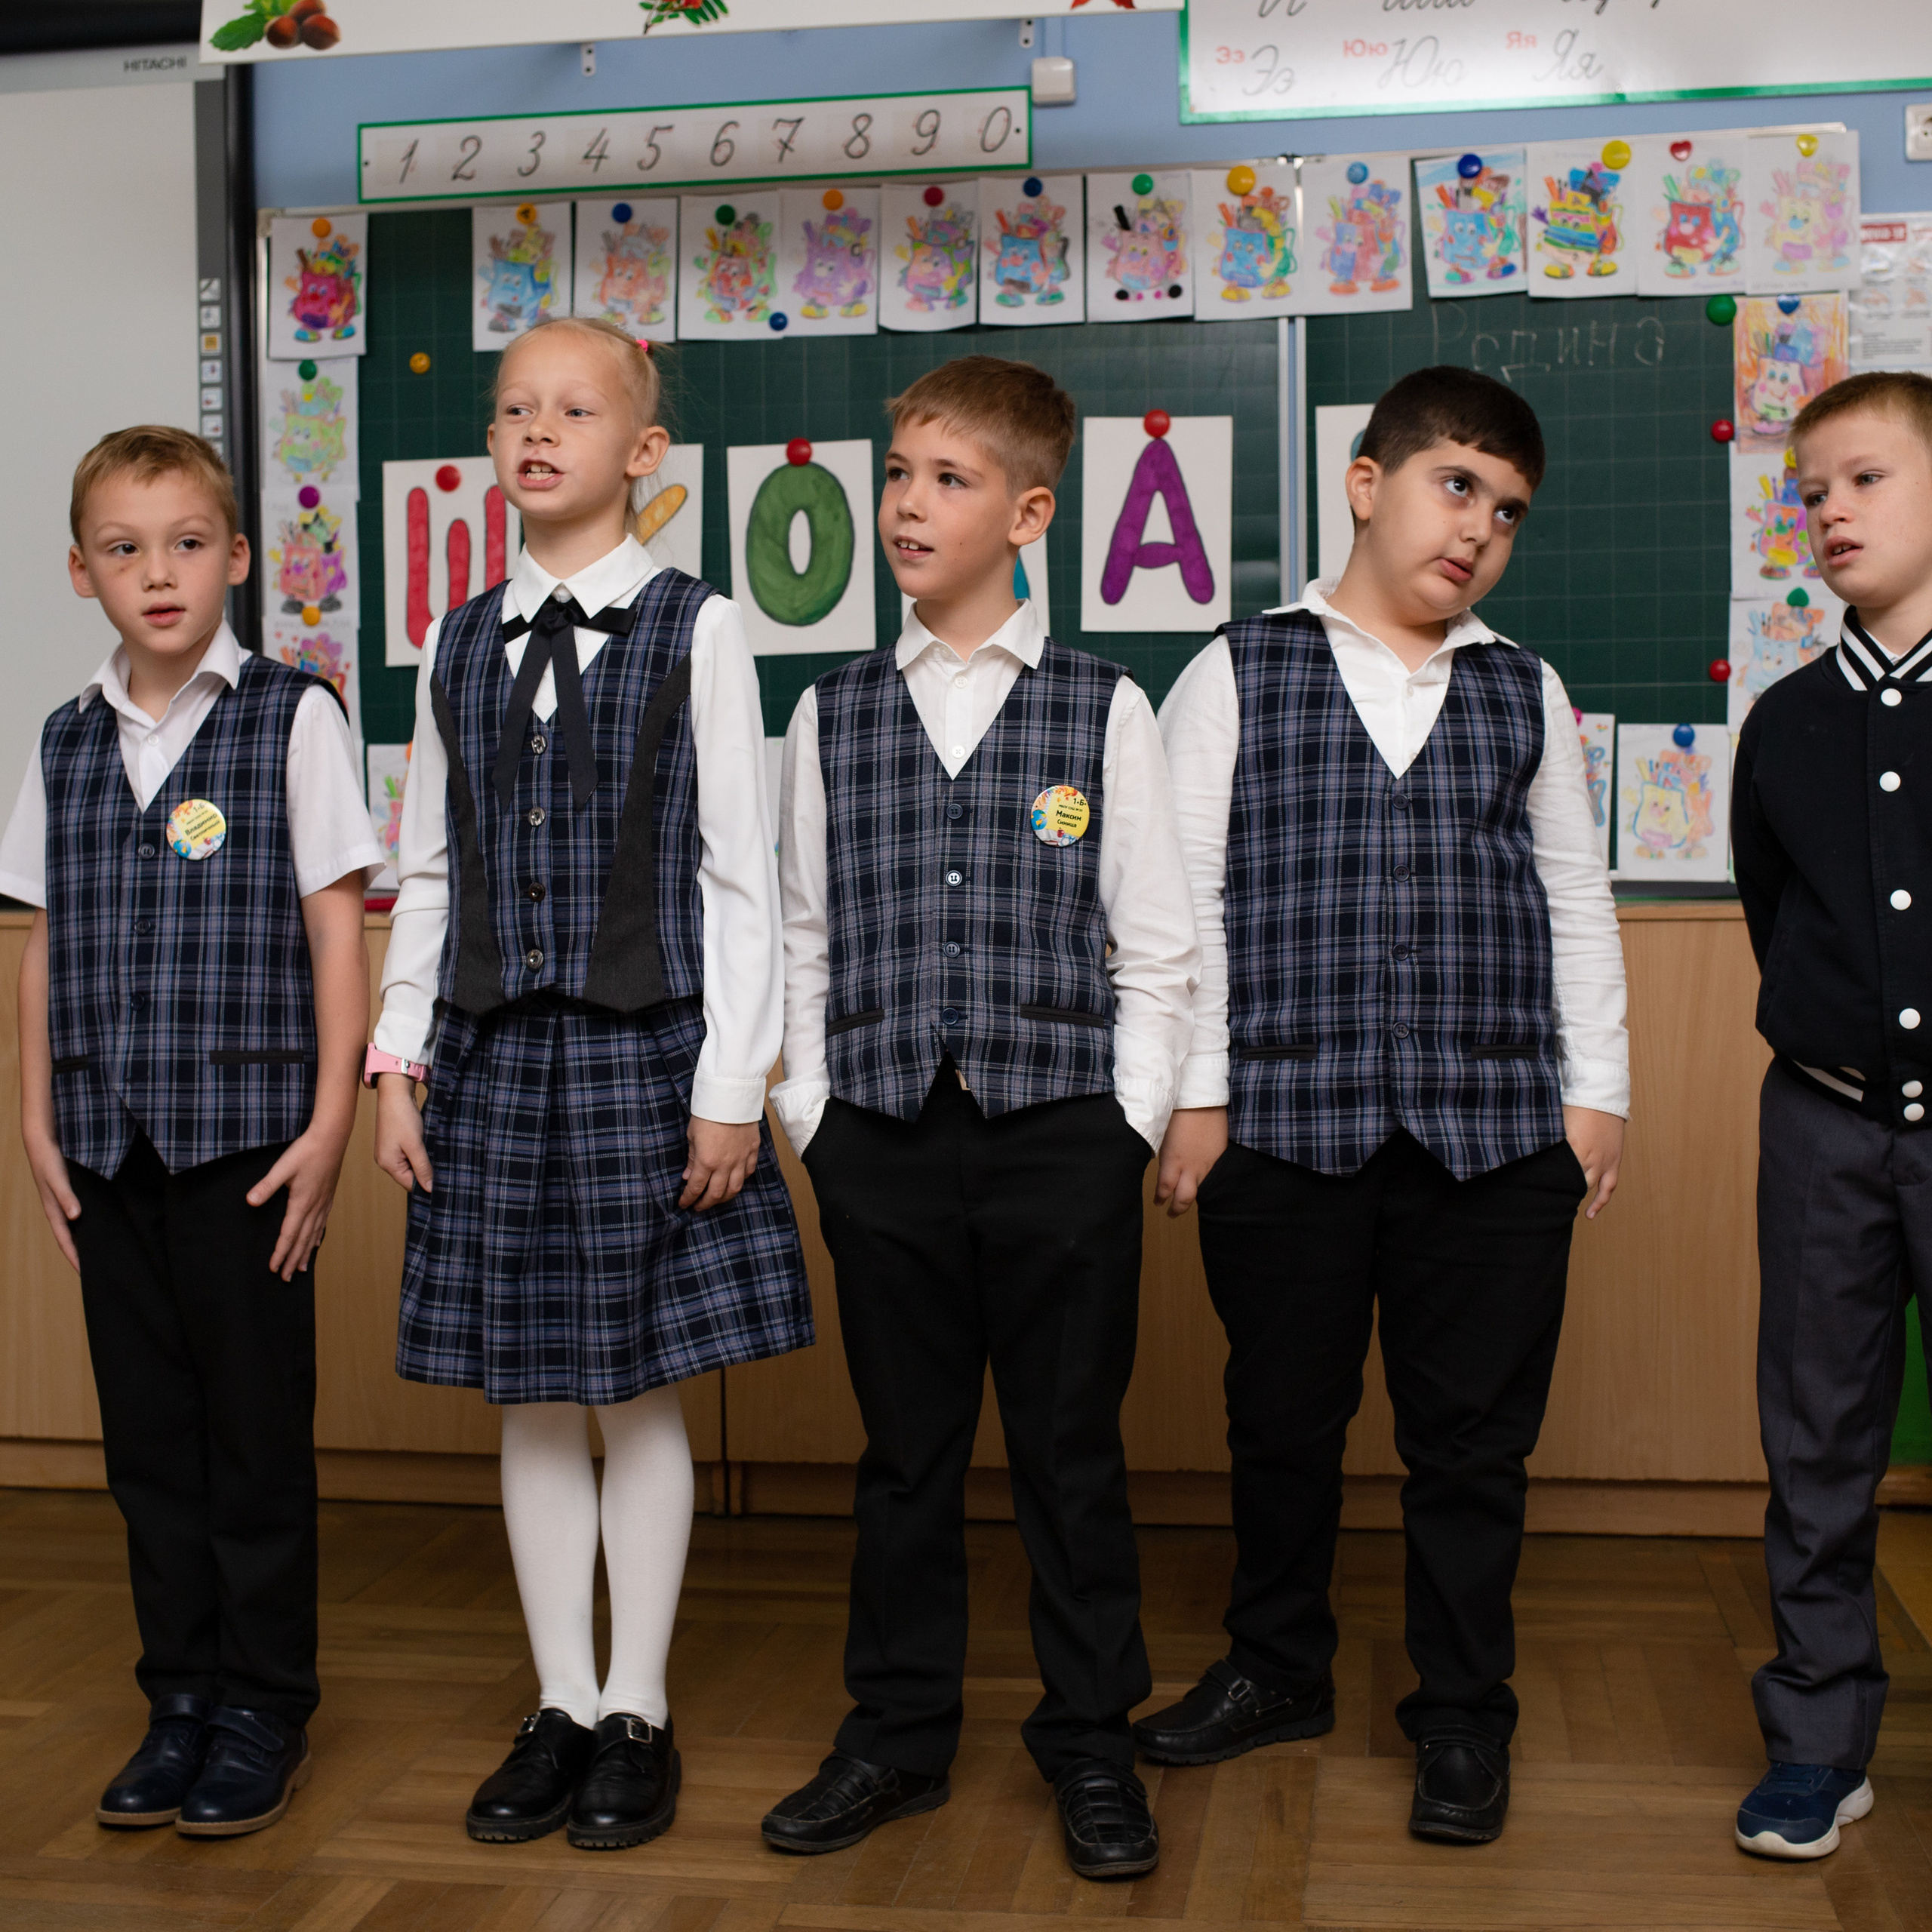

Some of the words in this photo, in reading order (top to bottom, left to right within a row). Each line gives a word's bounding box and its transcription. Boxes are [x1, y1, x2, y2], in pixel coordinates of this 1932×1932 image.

[1216, 45, 1244, 64] Ээ
[1343, 38, 1389, 58] Юю
[1506, 31, 1537, 50] Яя
[123, 57, 187, 72] HITACHI
[399, 138, 420, 185] 1
[451, 134, 483, 181] 2
[516, 131, 546, 177] 3
[583, 127, 610, 174] 4
[636, 125, 675, 171] 5
[709, 120, 740, 168] 6
[772, 117, 805, 163] 7
[843, 112, 873, 159] 8
[910, 109, 941, 155] 9
[980, 106, 1012, 153] 0
[1056, 810, 1081, 821] Максим
